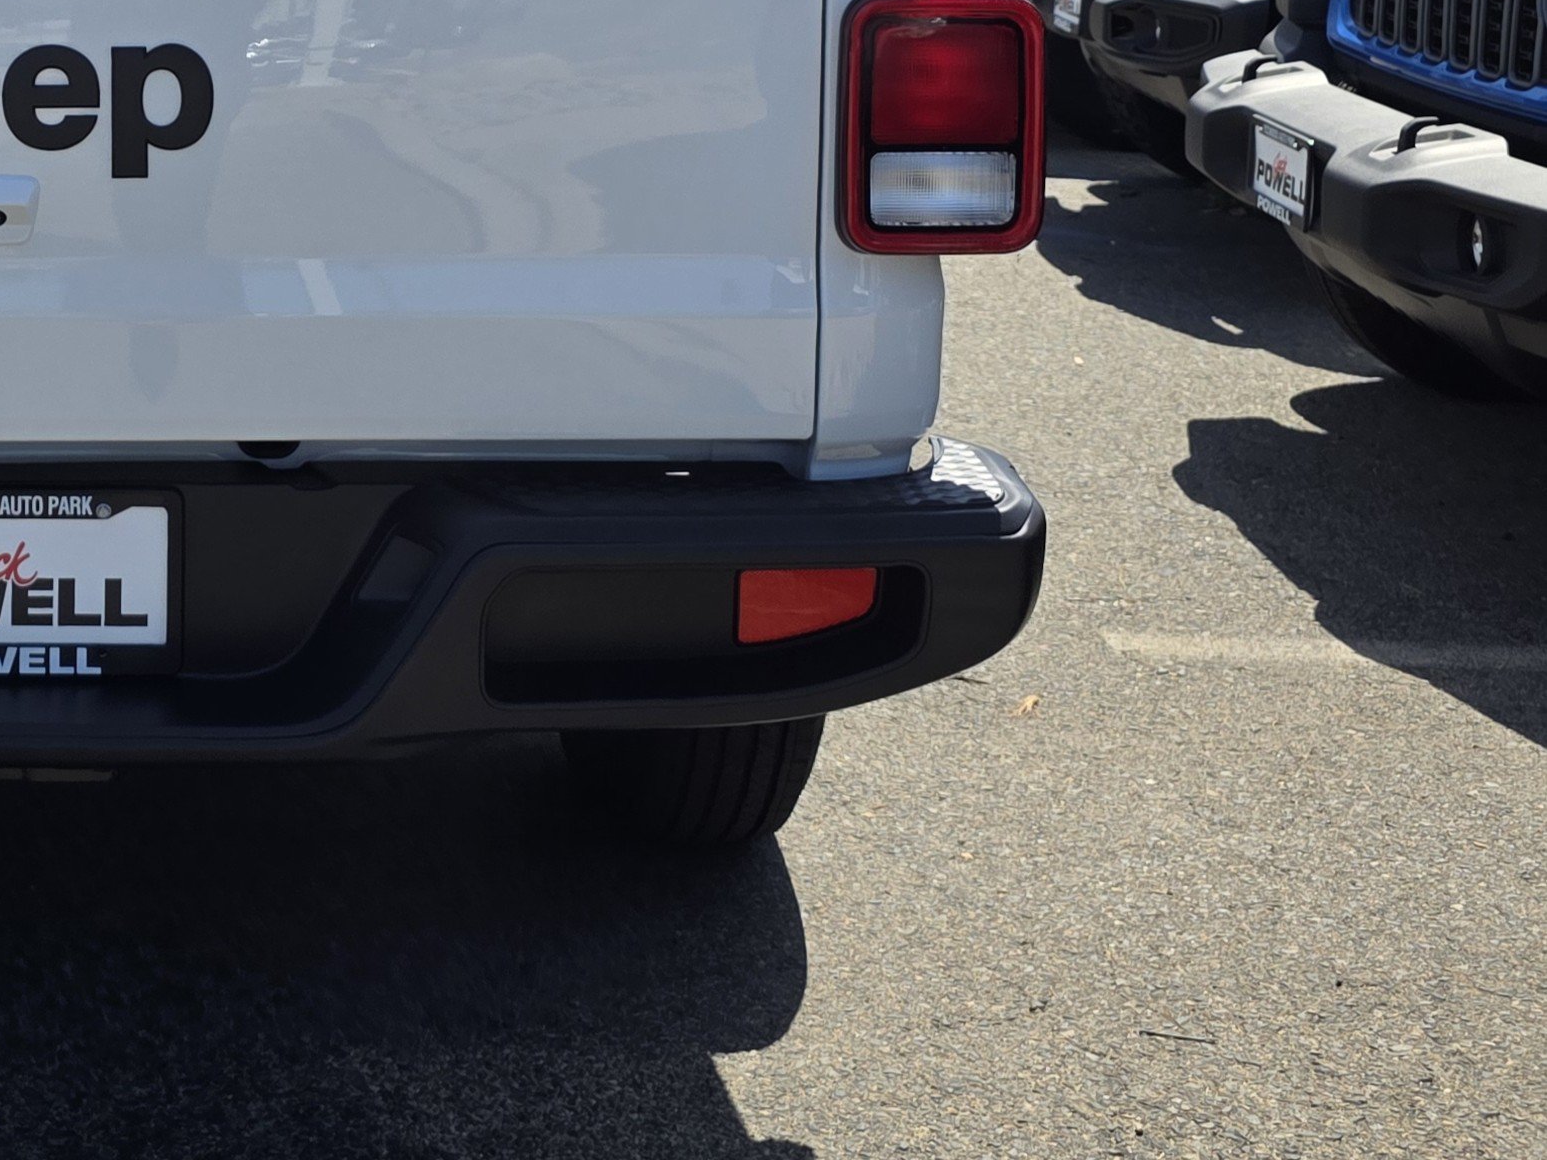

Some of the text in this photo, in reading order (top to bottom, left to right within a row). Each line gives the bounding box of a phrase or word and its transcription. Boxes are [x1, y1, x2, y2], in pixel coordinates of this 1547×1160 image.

[1257, 158, 1305, 206] POWELL
[0, 495, 44, 516] AUTO
[48, 495, 93, 516] PARK
